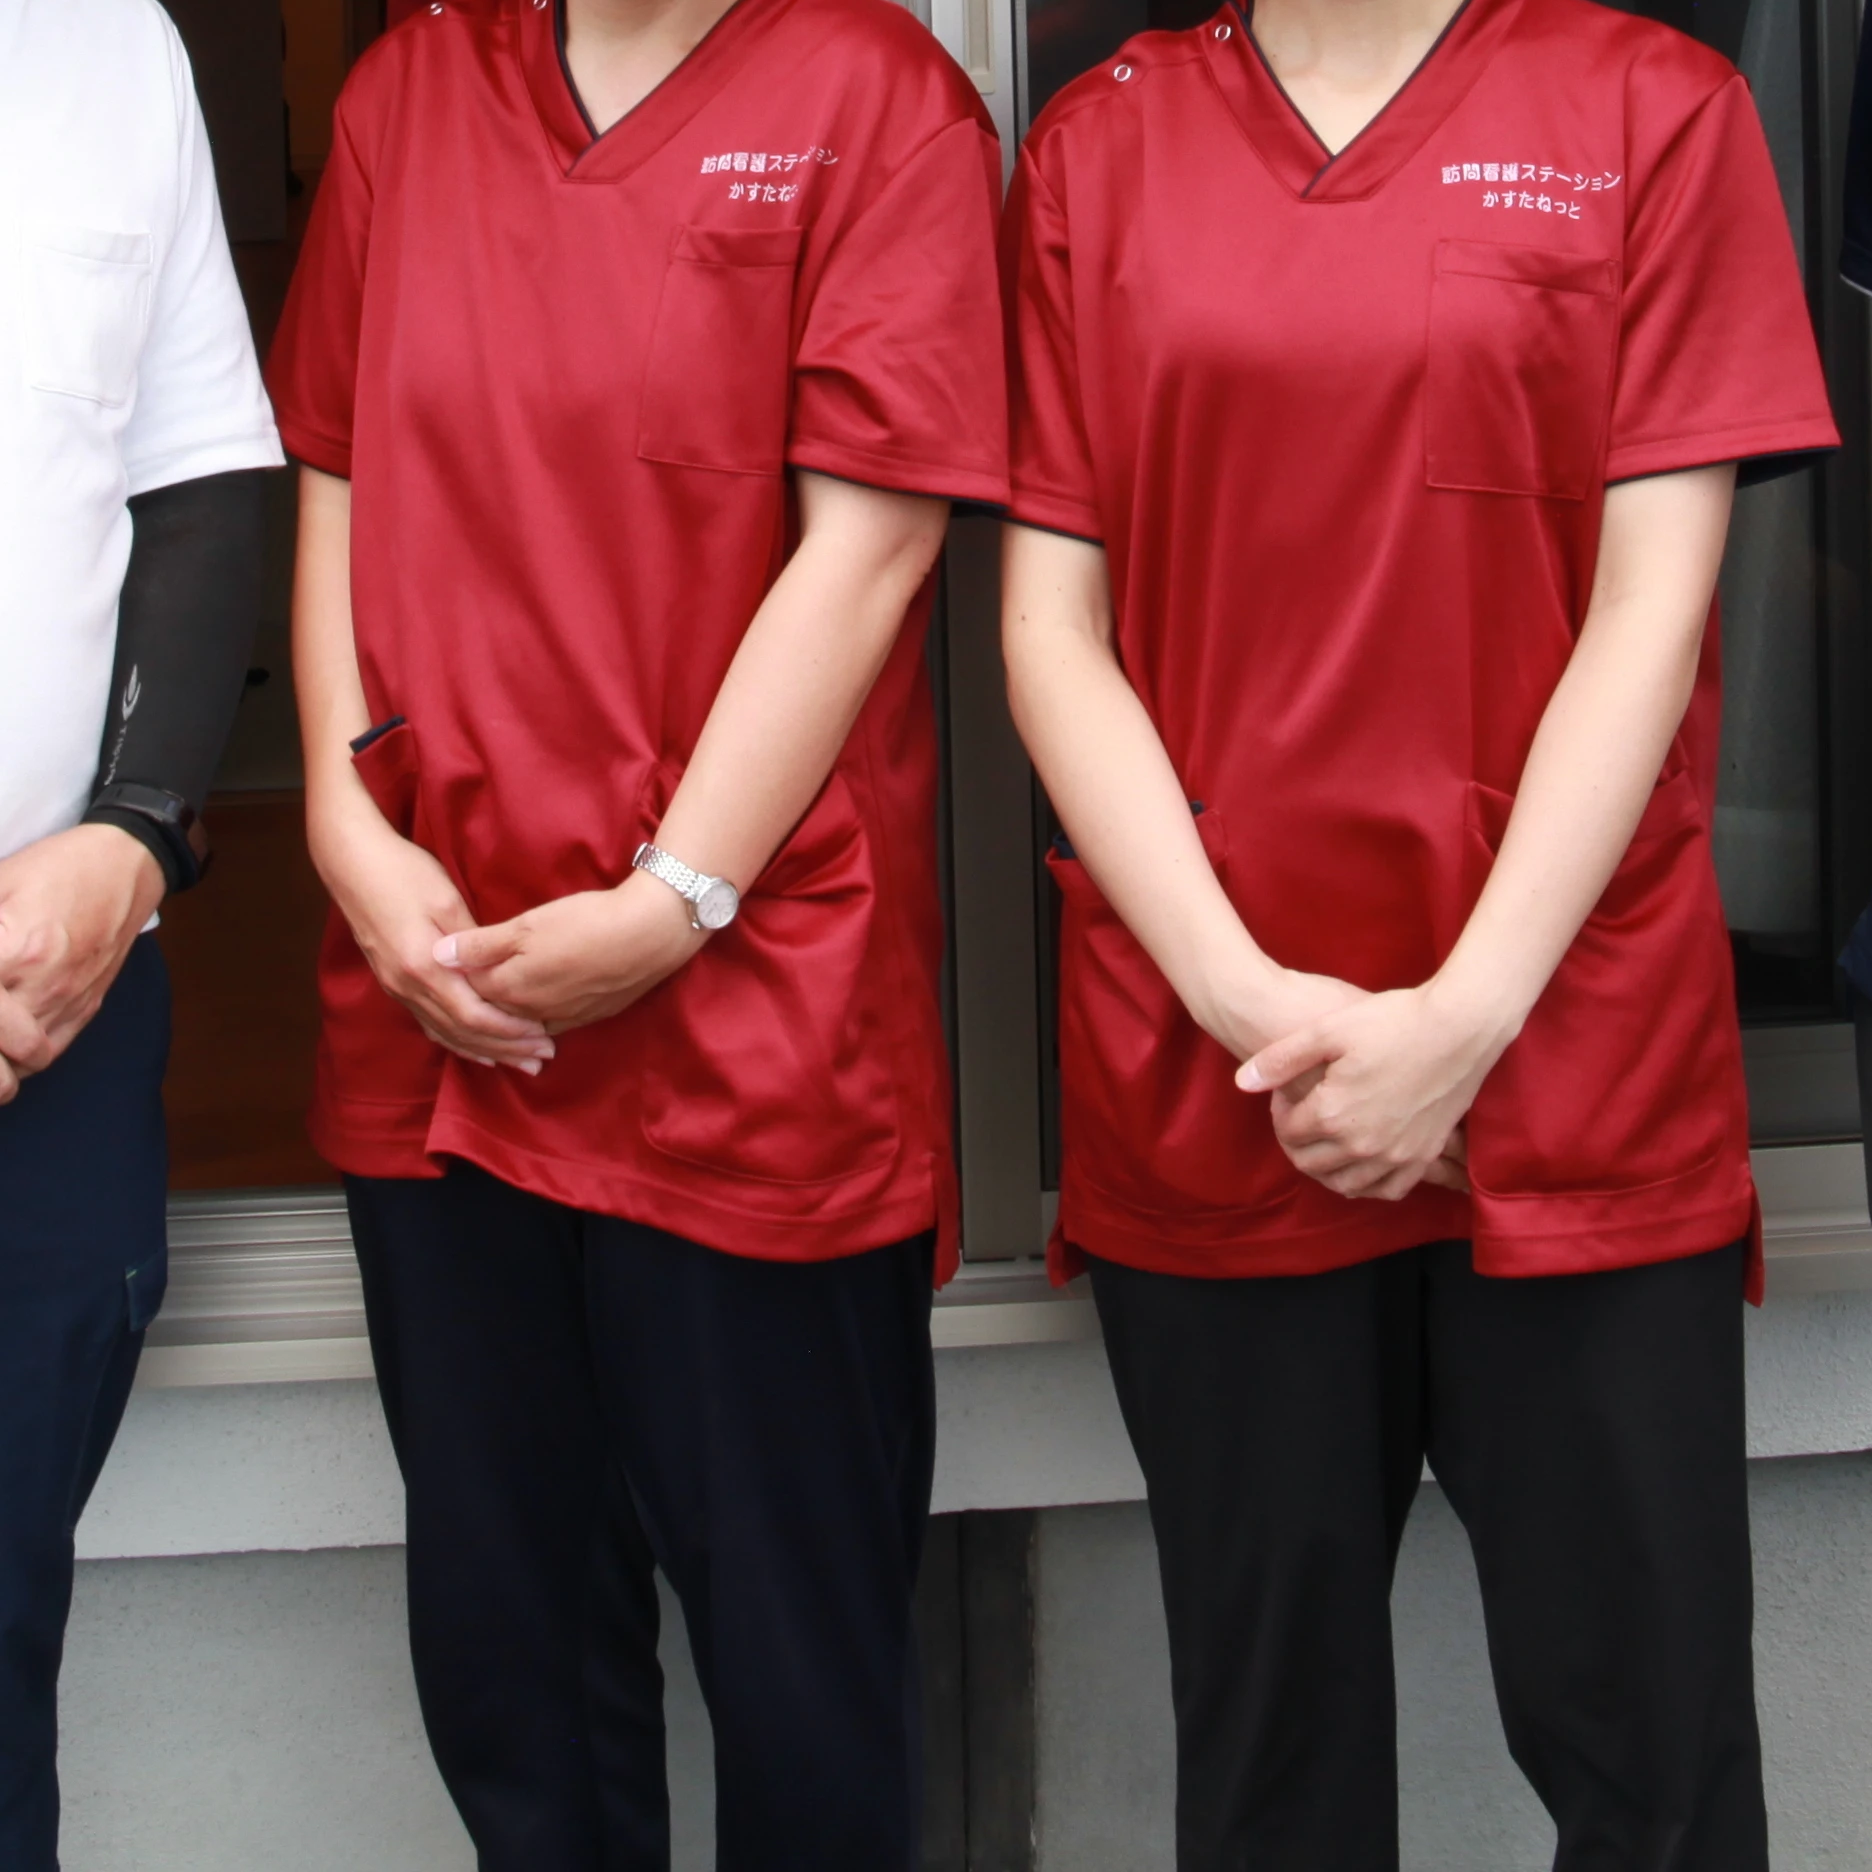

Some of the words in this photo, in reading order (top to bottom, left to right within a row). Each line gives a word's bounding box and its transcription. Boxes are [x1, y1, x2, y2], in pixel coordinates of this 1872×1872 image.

[1441, 162, 1621, 191] 訪問看護ステーション
[1482, 190, 1581, 219] かすたねっと
